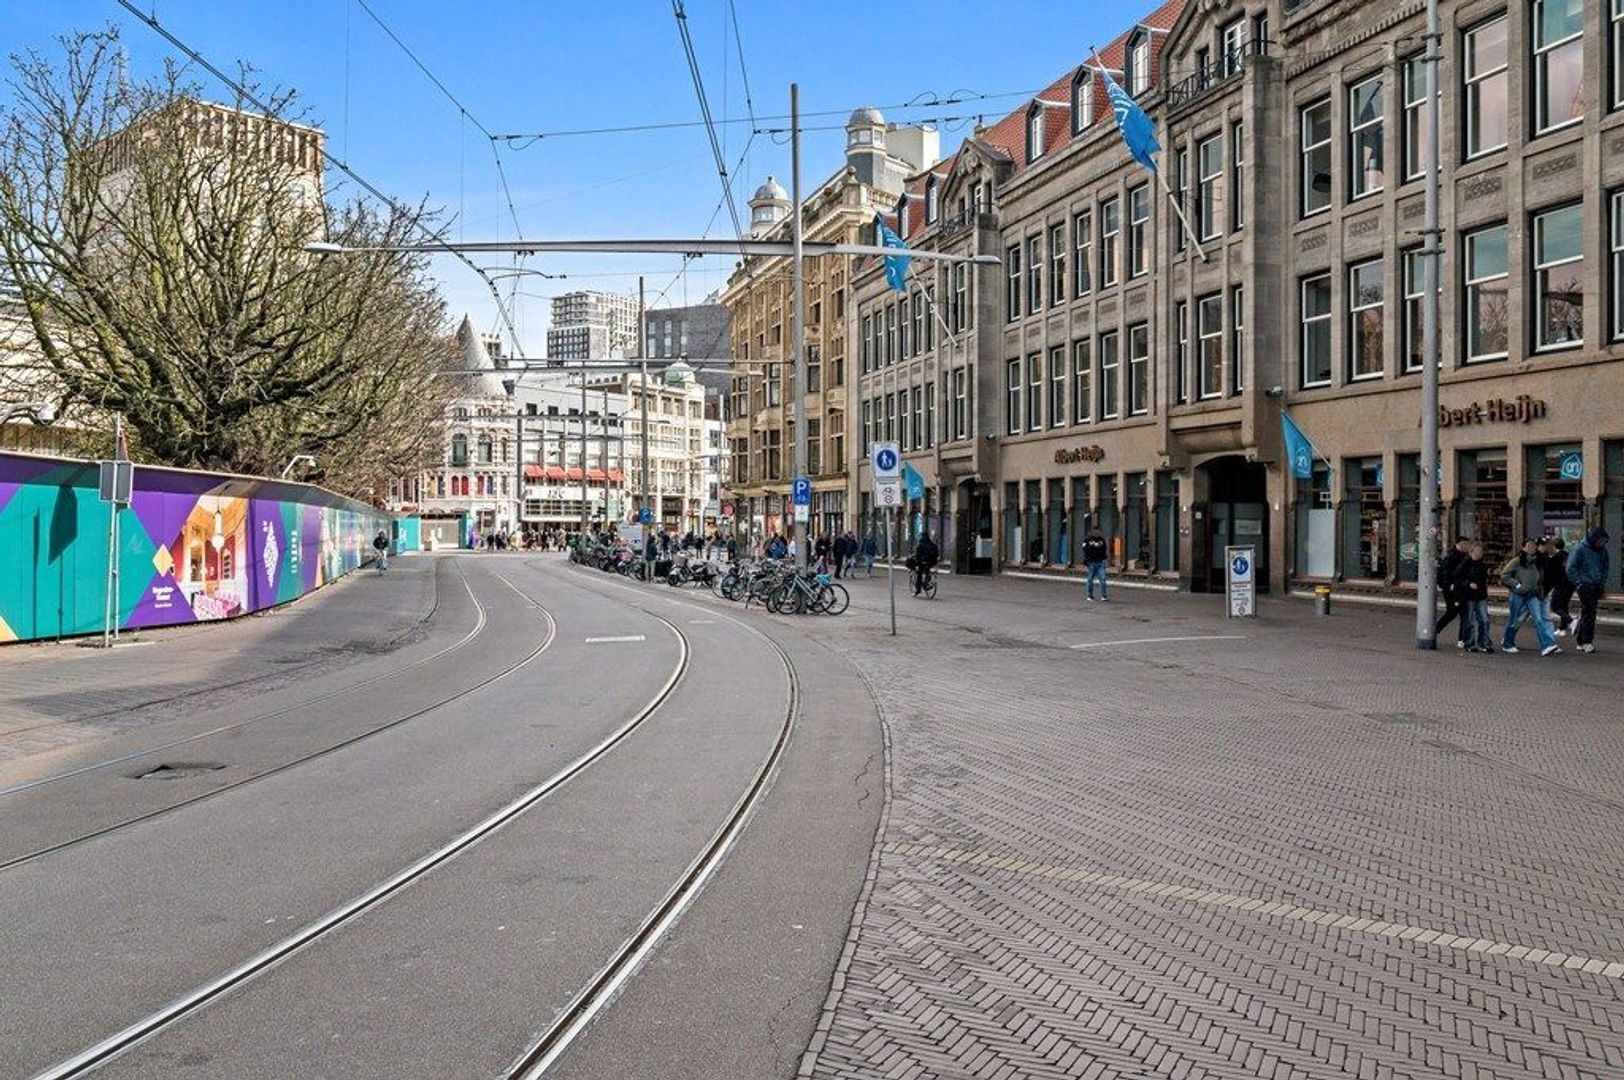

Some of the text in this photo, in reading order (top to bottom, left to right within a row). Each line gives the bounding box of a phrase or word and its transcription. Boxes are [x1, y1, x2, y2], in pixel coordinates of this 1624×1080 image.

[1418, 394, 1546, 427] bert Heijn
[796, 480, 807, 495] P
